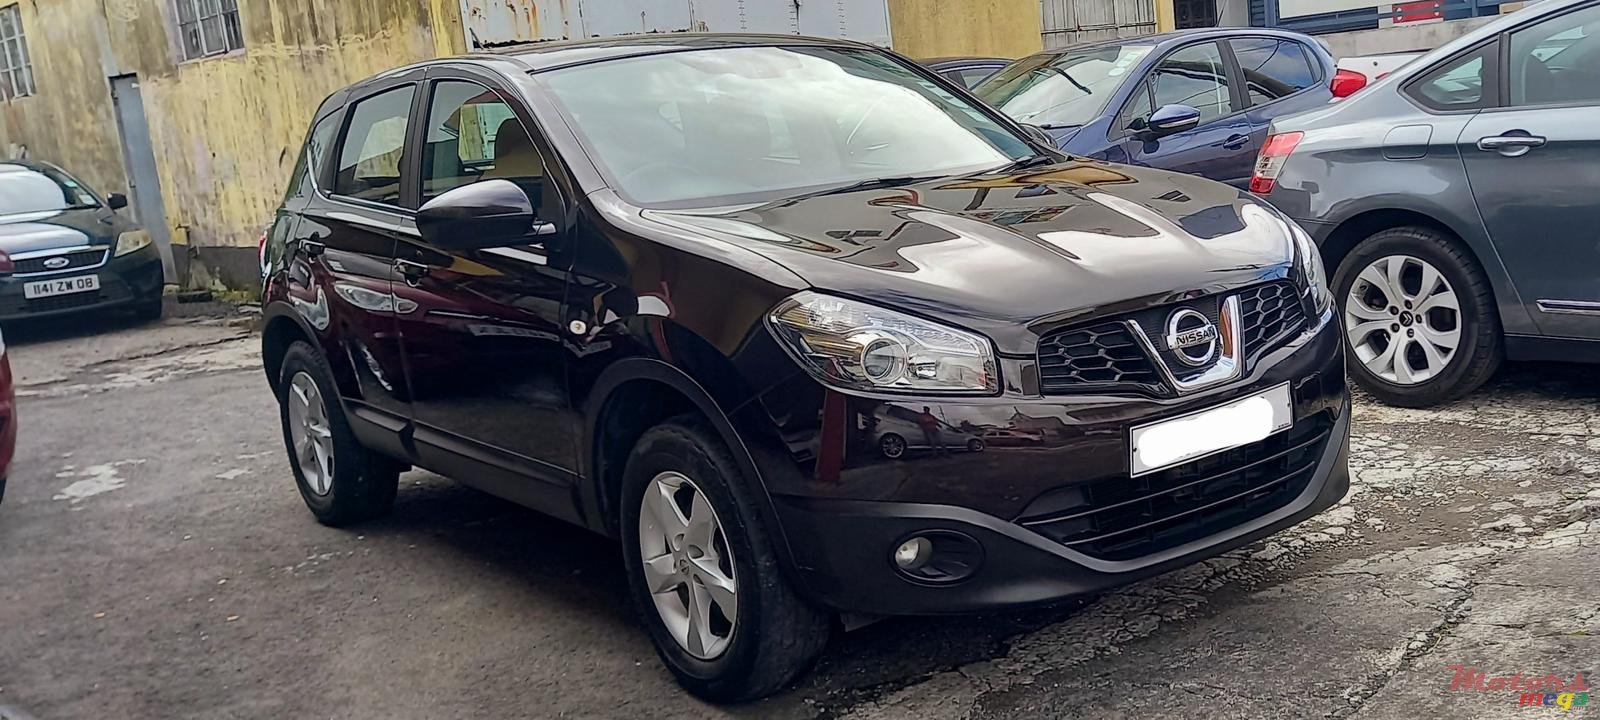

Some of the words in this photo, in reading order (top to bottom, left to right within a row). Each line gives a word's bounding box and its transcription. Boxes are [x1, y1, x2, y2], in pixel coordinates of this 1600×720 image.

[33, 283, 53, 295] 1141
[77, 278, 93, 289] 08
[1176, 326, 1217, 345] NISSAN
